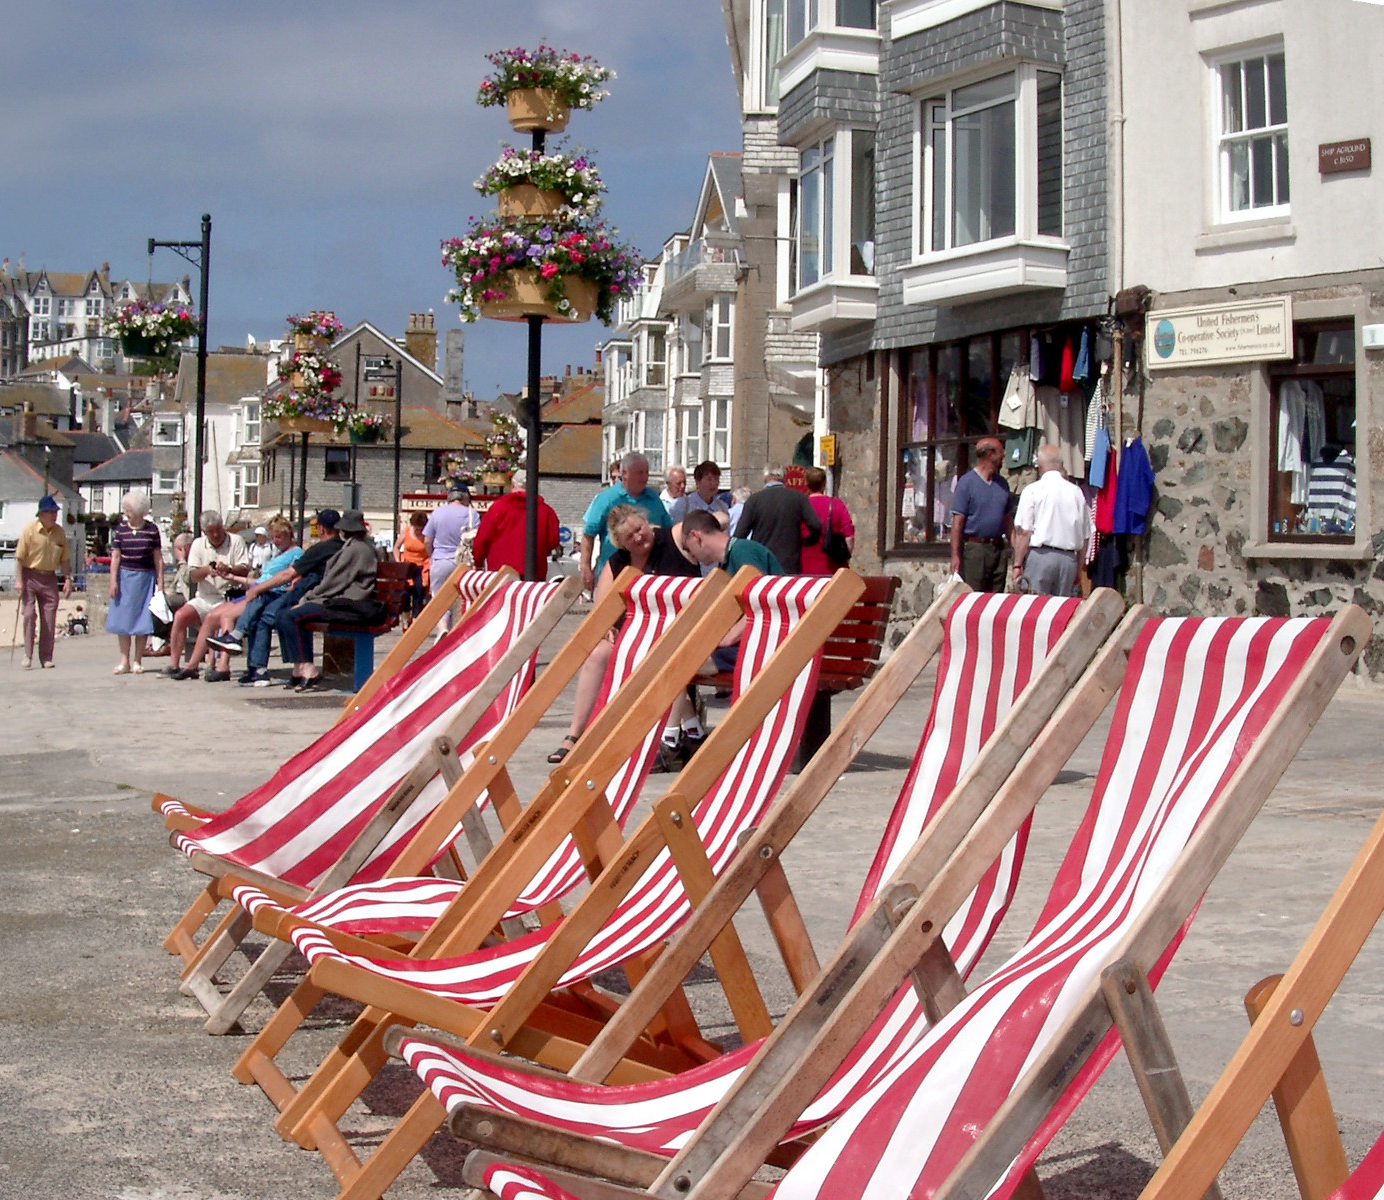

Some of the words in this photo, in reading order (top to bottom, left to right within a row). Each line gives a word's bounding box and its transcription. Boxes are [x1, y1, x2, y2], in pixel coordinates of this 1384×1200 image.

[1322, 148, 1335, 157] SHIP
[1336, 143, 1366, 153] AGROUND
[1196, 316, 1219, 328] United
[1221, 311, 1260, 325] Fishermen's
[1177, 331, 1214, 344] Co-operative
[1216, 327, 1239, 342] Society
[1256, 323, 1281, 336] Limited
[411, 500, 434, 508] ICE
